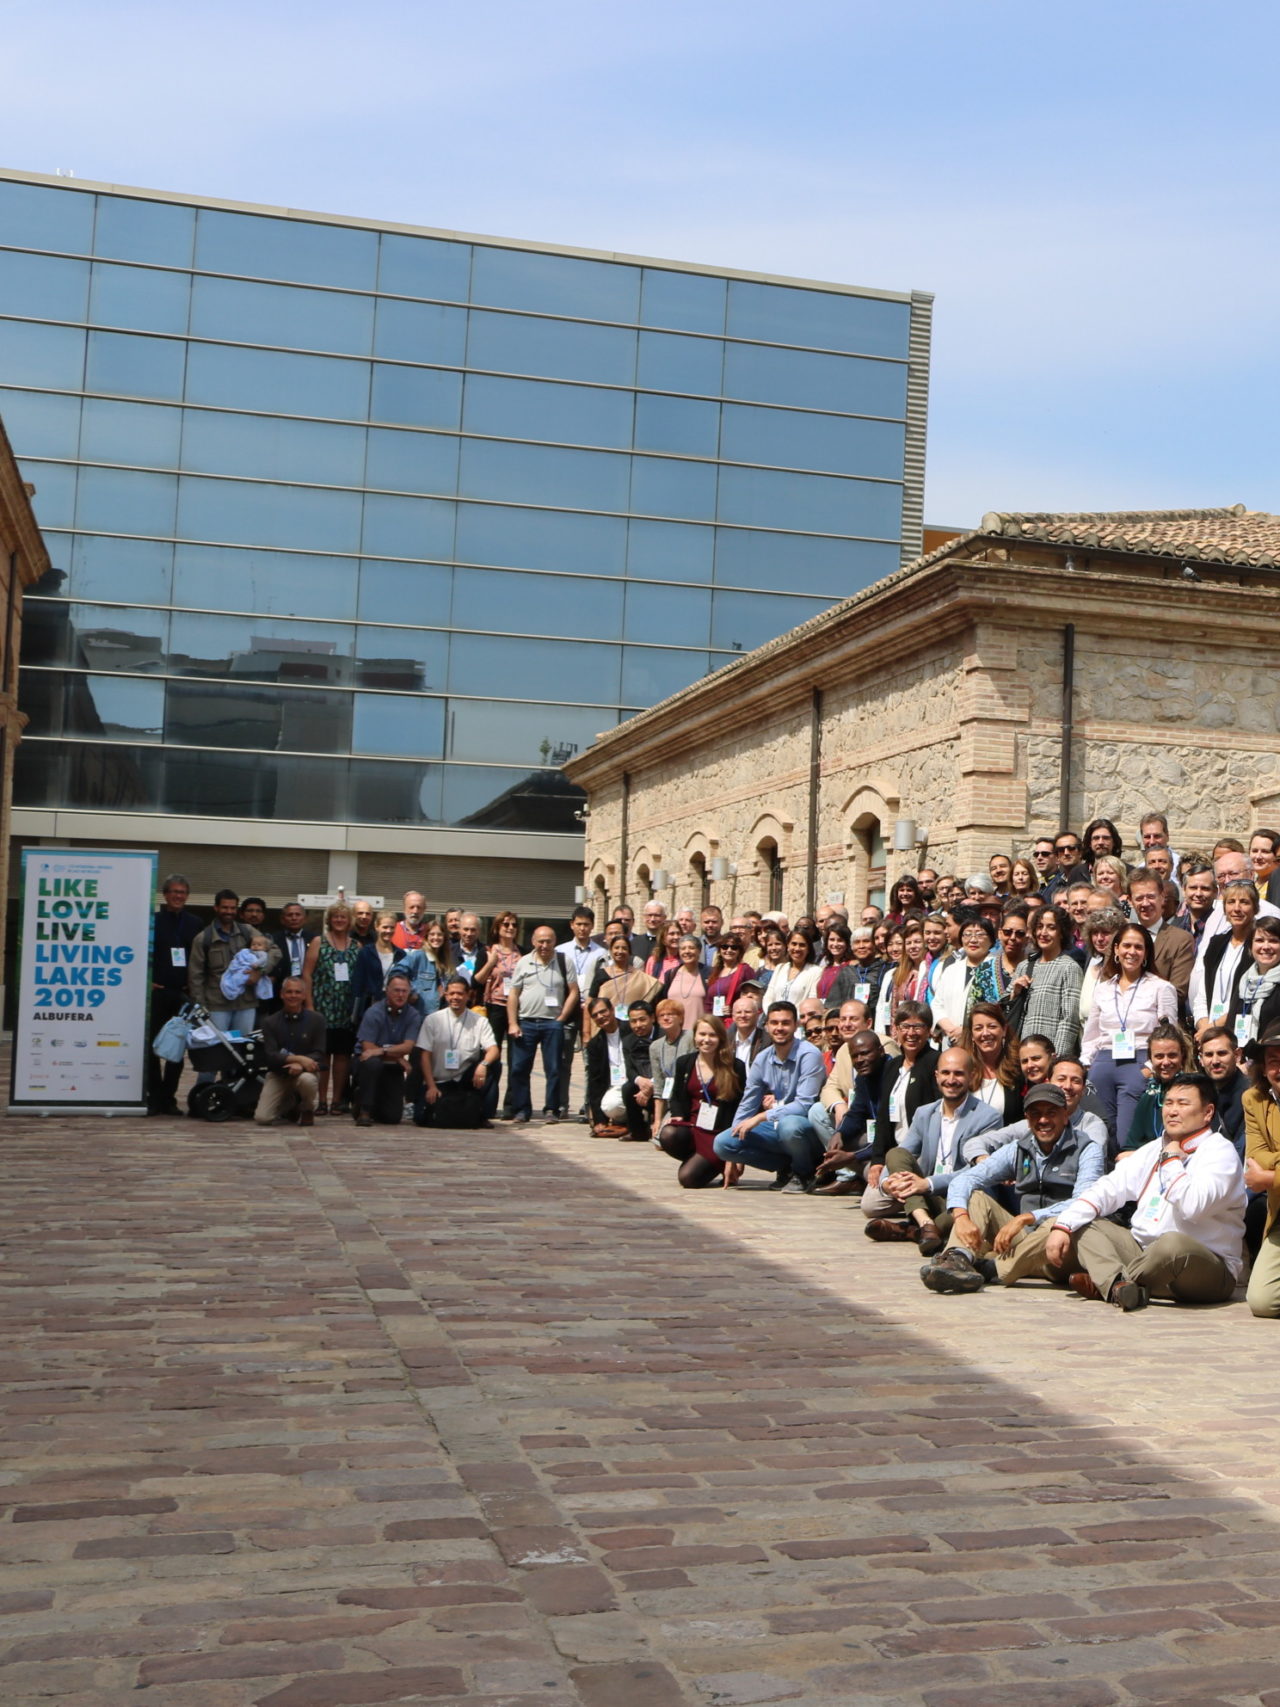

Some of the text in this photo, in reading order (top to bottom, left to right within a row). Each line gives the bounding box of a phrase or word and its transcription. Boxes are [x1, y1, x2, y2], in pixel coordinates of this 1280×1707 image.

[38, 878, 98, 898] LIKE
[37, 900, 109, 920] LOVE
[36, 922, 96, 941] LIVE
[36, 944, 134, 964] LIVING
[34, 966, 122, 986] LAKES
[33, 988, 106, 1008] 2019
[33, 1012, 93, 1021] ALBUFERA
